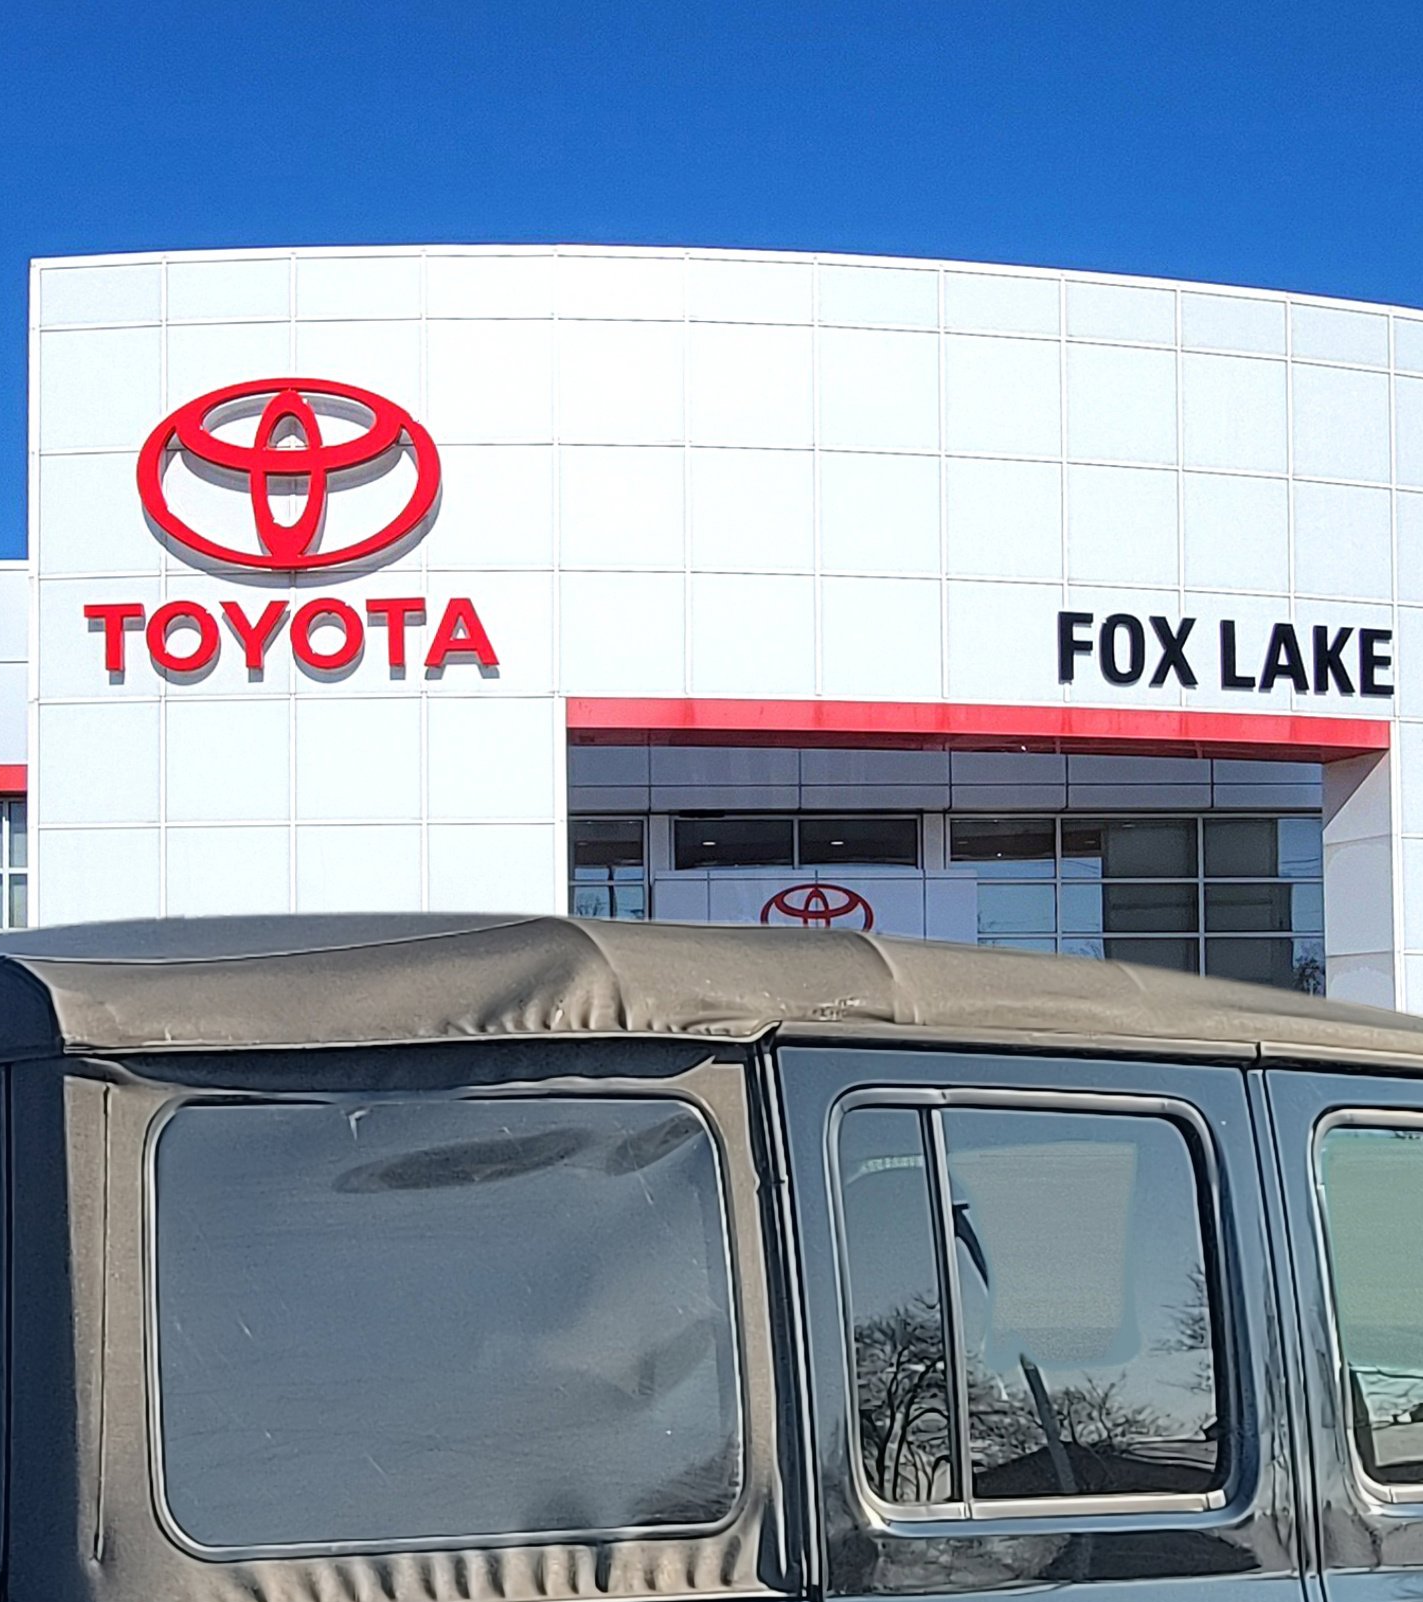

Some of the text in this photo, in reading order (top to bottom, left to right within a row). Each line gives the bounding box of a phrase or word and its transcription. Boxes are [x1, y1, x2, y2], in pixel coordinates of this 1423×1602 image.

[84, 597, 500, 679] TOYOTA
[1057, 611, 1395, 697] FOX LAKE
